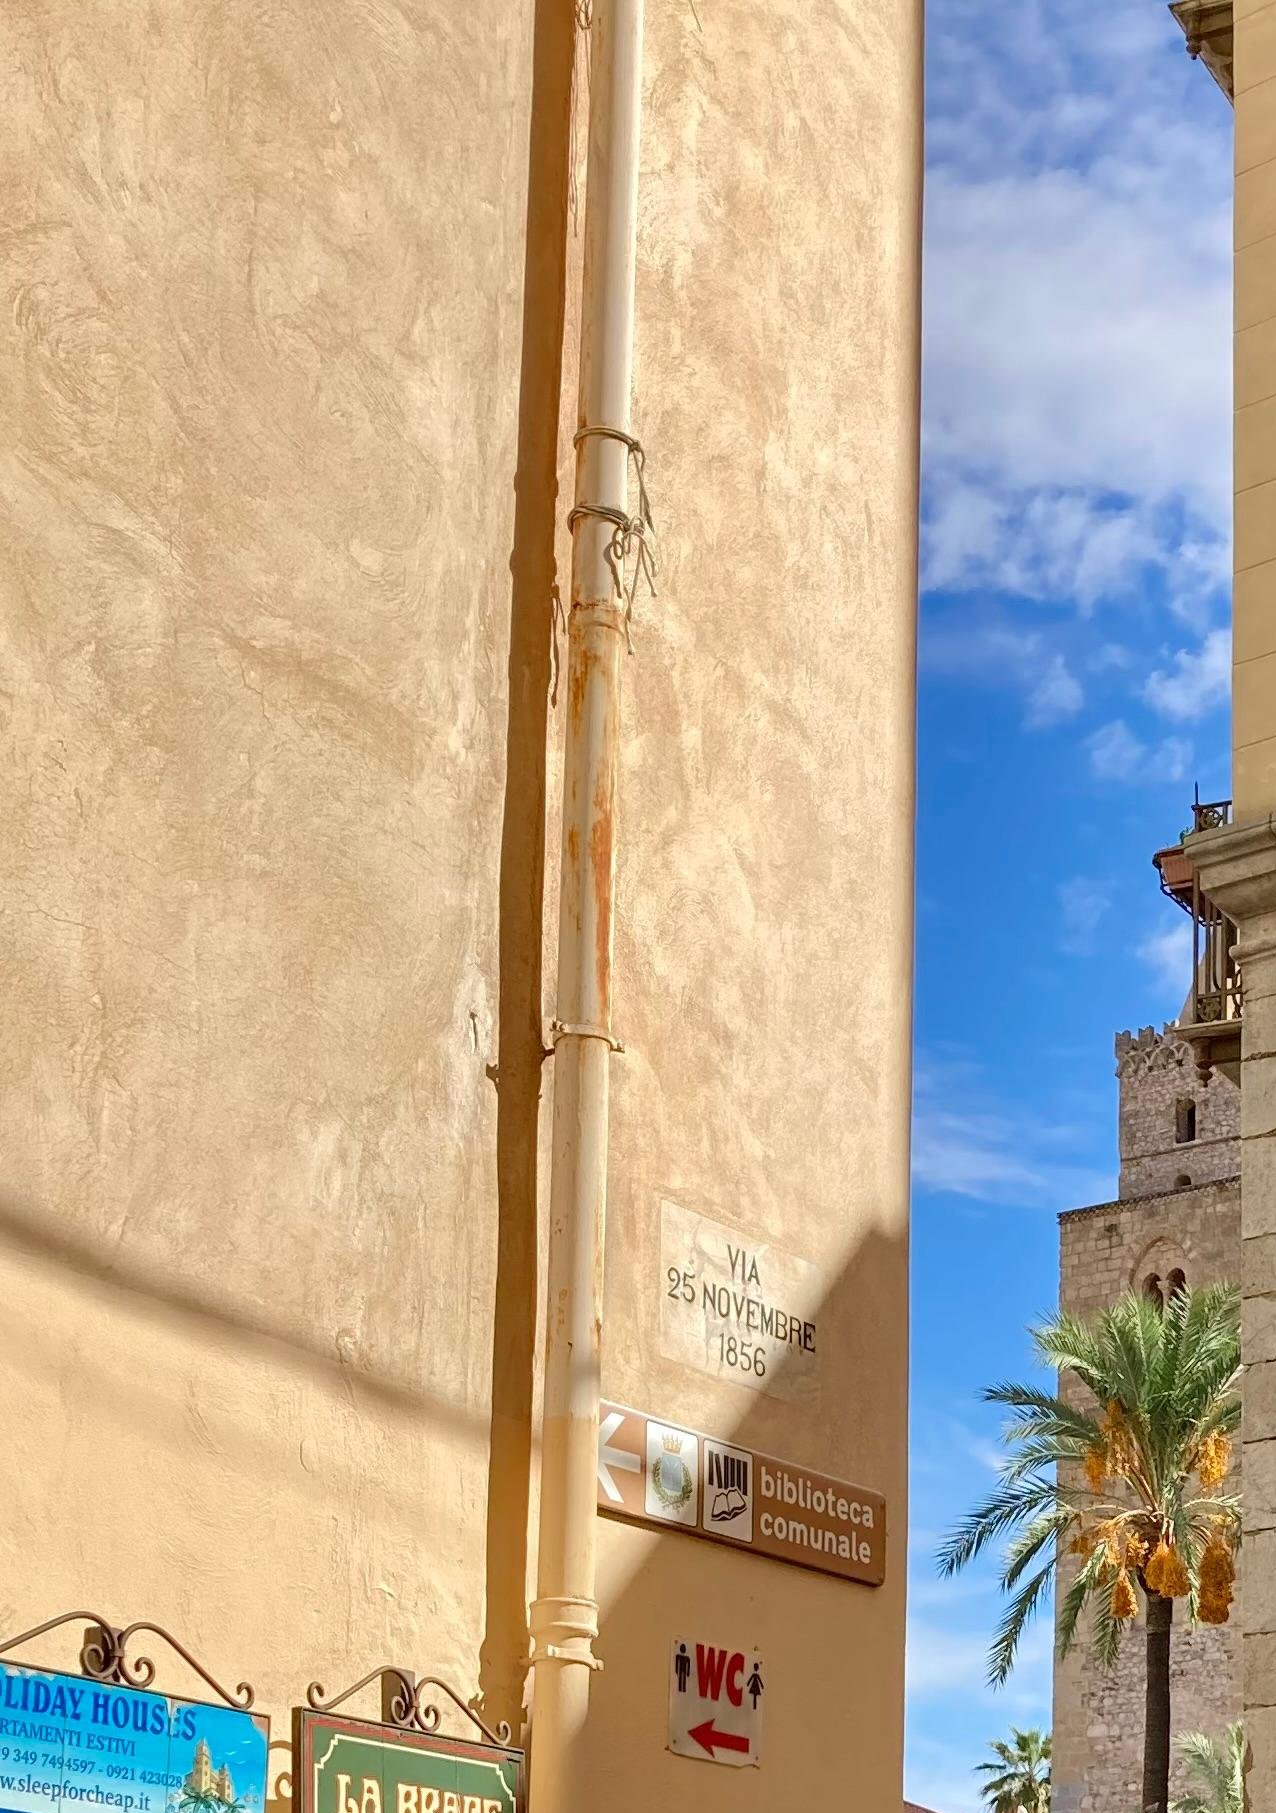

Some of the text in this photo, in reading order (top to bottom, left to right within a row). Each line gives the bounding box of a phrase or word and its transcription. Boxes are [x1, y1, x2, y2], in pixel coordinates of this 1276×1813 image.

[727, 1244, 761, 1286] VIA
[667, 1267, 816, 1354] 25 NOVEMBRE
[719, 1331, 766, 1378] 1856
[761, 1466, 874, 1530] biblioteca
[760, 1511, 871, 1564] comunale
[696, 1643, 744, 1708] WC
[0, 1675, 198, 1741] LIDAY HOUSES
[12, 1748, 38, 1766] 349
[41, 1753, 96, 1775] 7494597
[106, 1765, 135, 1782] 0921
[139, 1771, 183, 1789] 423028
[86, 1733, 136, 1757] ESTIVI
